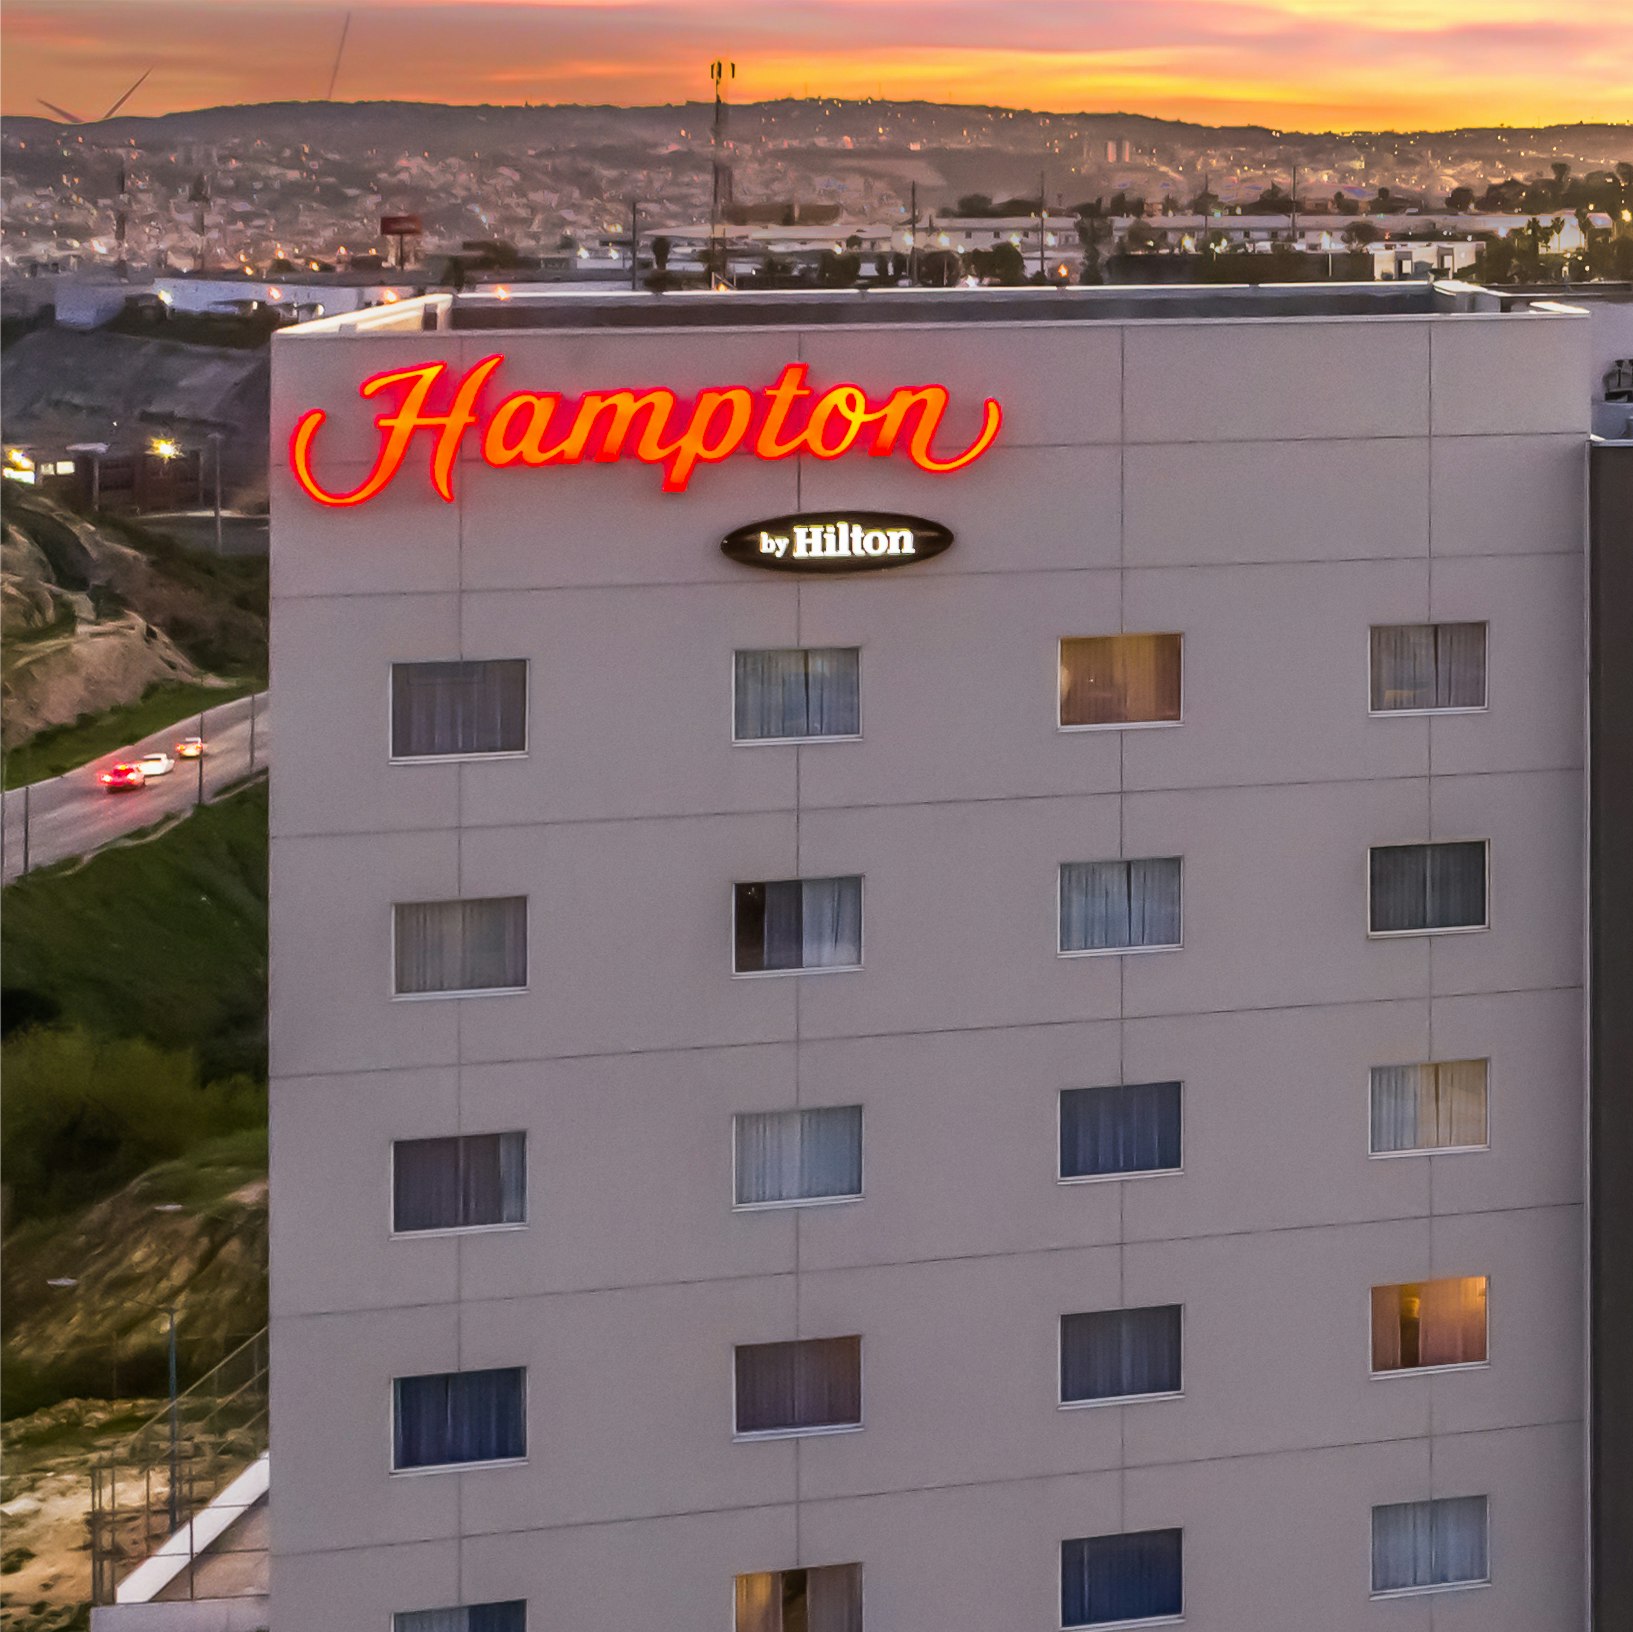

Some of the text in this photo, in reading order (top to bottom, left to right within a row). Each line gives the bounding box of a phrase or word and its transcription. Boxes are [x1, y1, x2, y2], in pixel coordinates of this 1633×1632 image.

[289, 354, 1002, 506] Hampton
[759, 521, 916, 559] by Hilton
